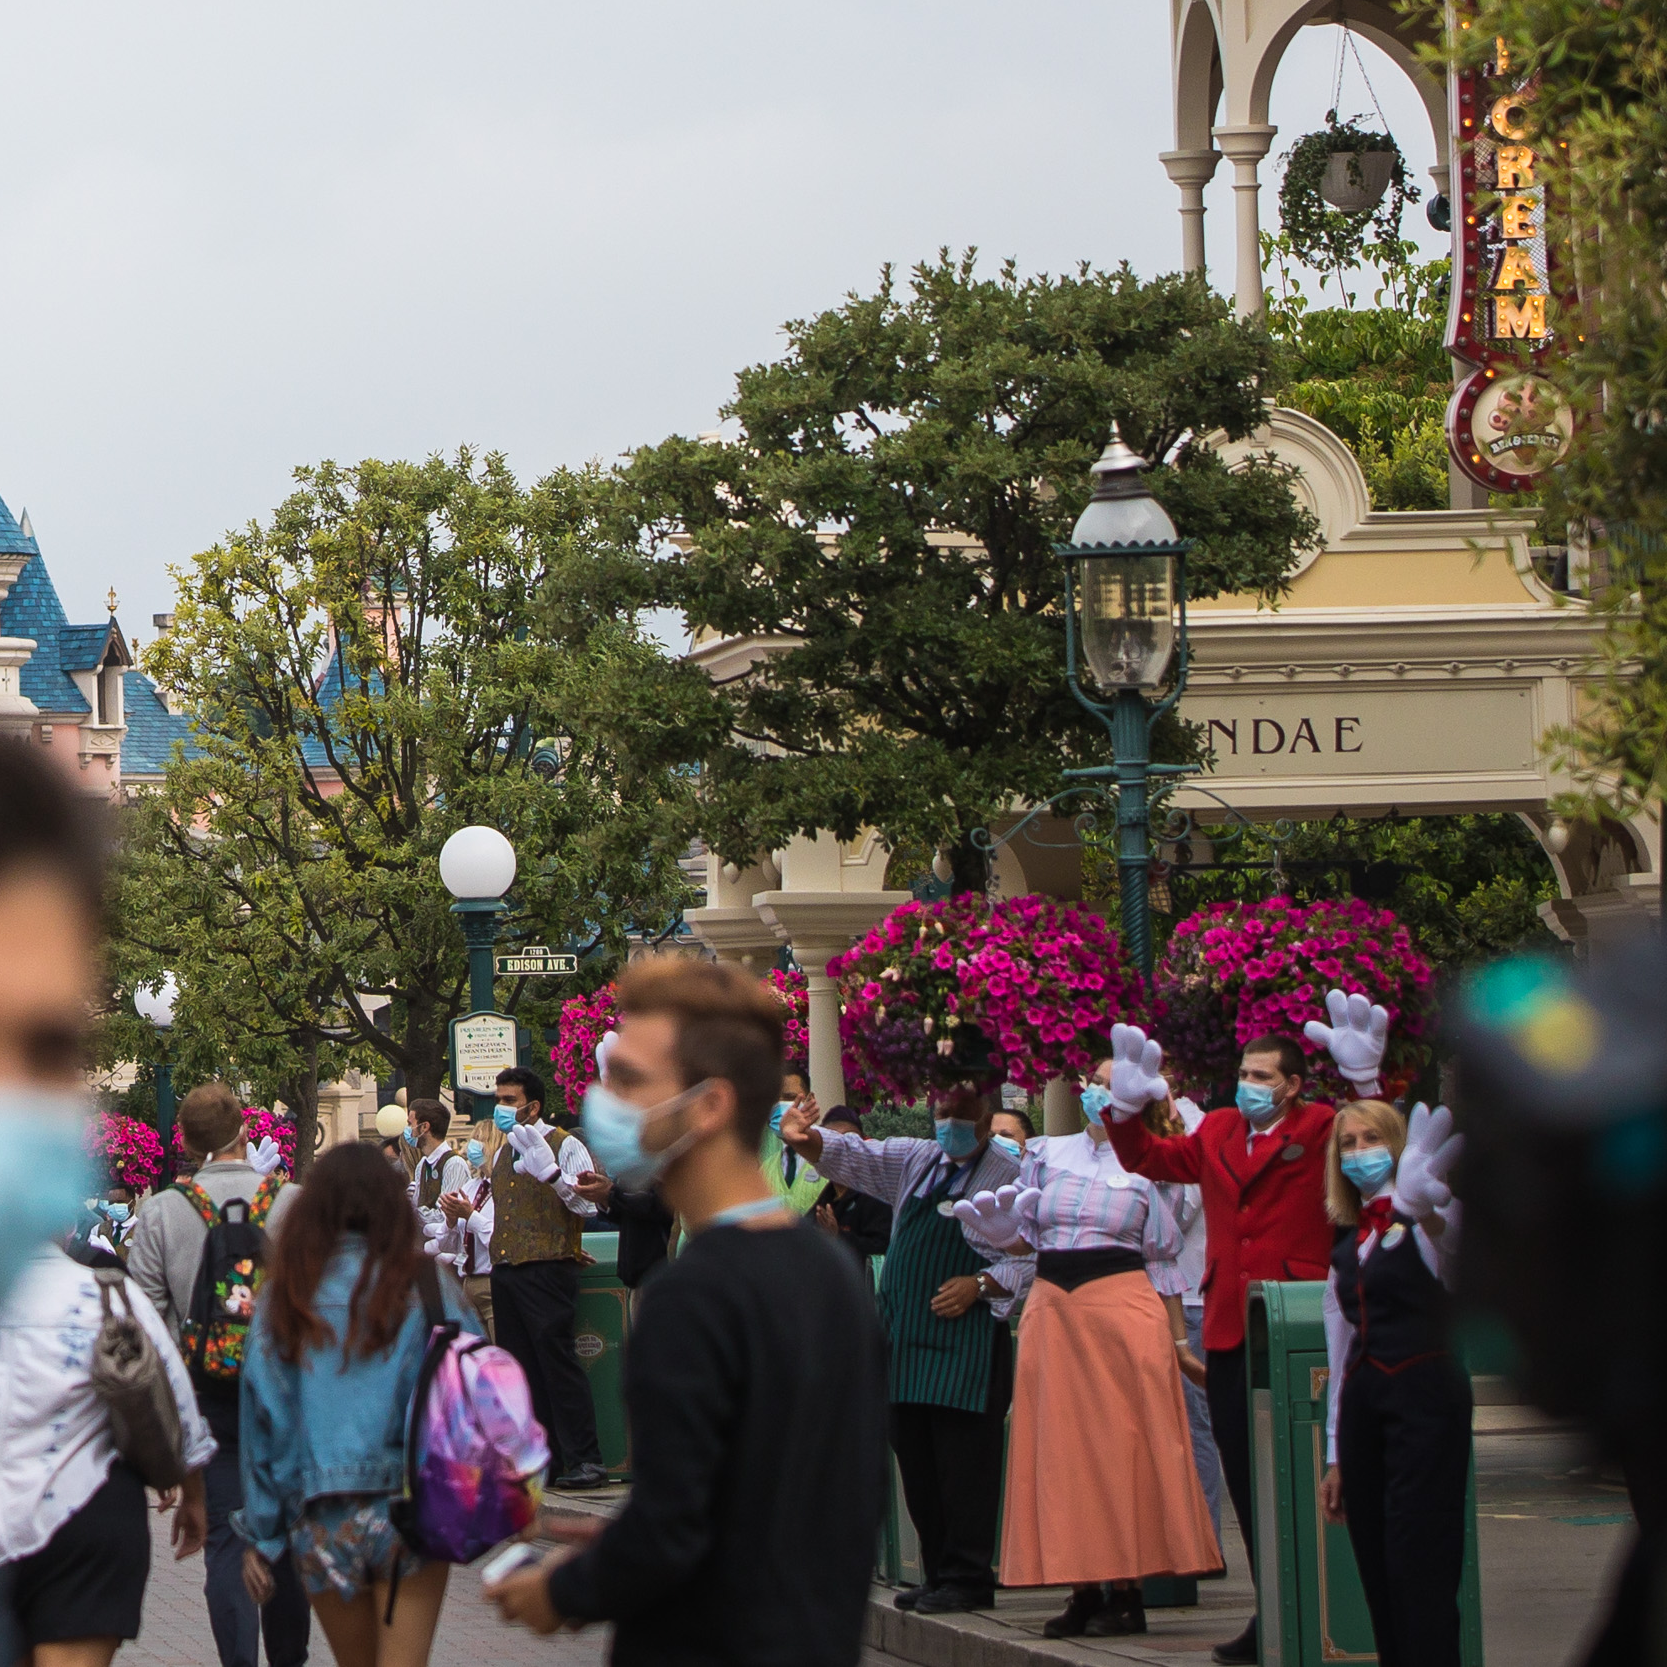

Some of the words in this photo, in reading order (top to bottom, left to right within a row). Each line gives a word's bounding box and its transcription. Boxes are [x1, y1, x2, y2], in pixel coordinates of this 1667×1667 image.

[1491, 94, 1546, 339] CREAM
[1207, 717, 1364, 755] NDAE
[507, 959, 544, 971] EDISON
[547, 958, 570, 971] AVE.
